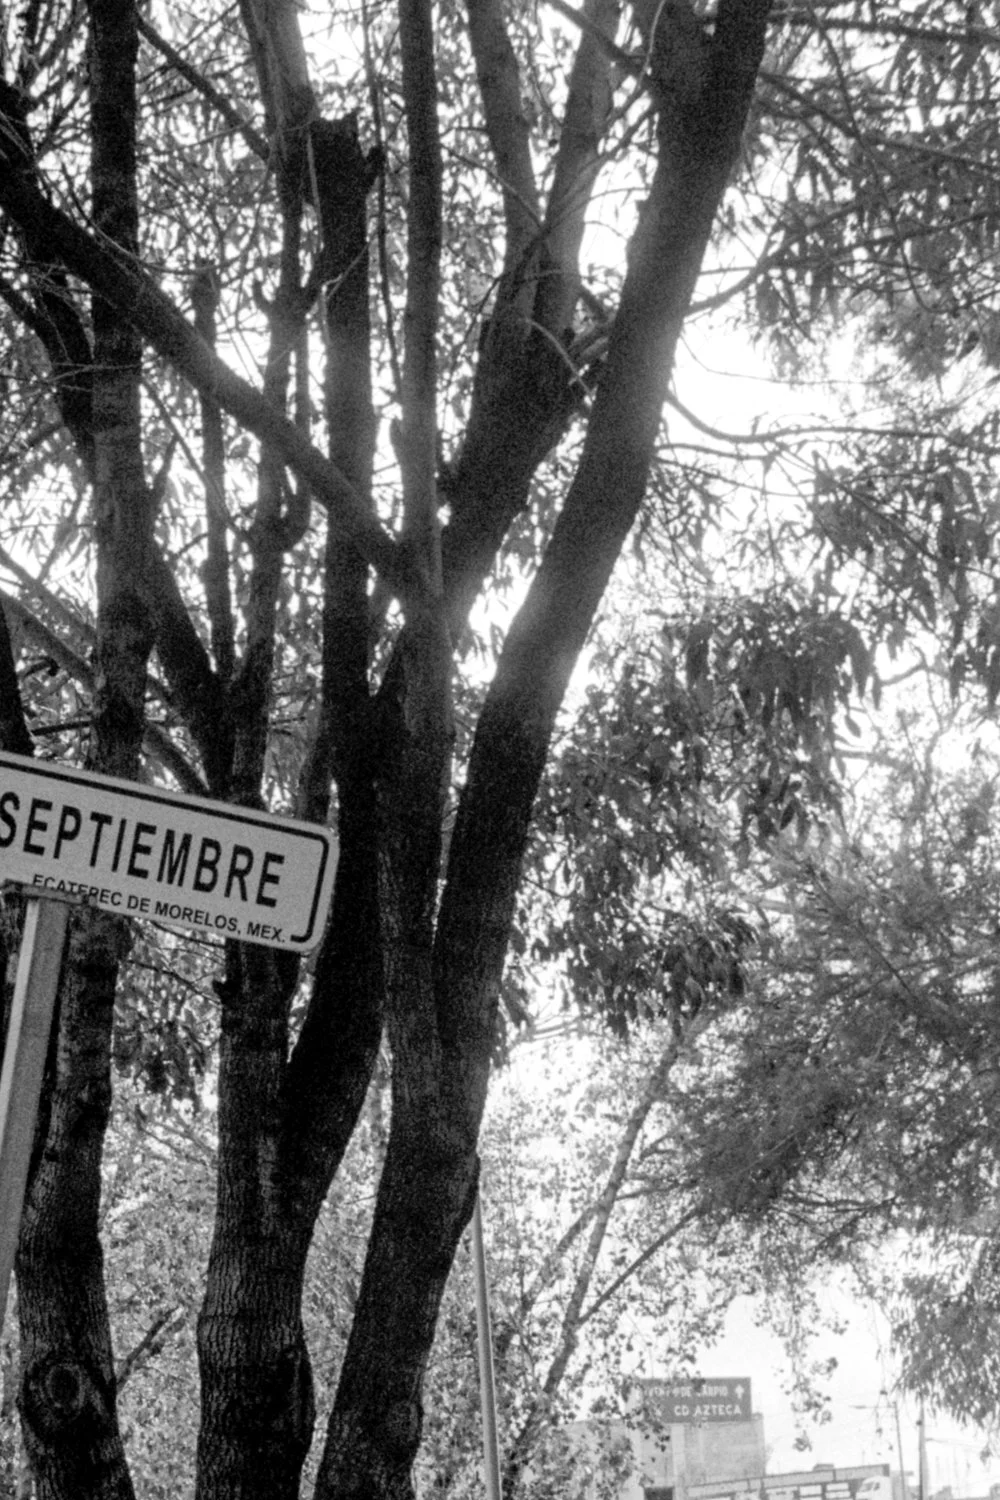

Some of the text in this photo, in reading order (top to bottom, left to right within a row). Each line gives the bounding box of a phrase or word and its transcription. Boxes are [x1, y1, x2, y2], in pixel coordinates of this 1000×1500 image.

[32, 873, 286, 943] ECATEPEC DE MORELOS, MEX.
[674, 1403, 742, 1417] CD AZTECA
